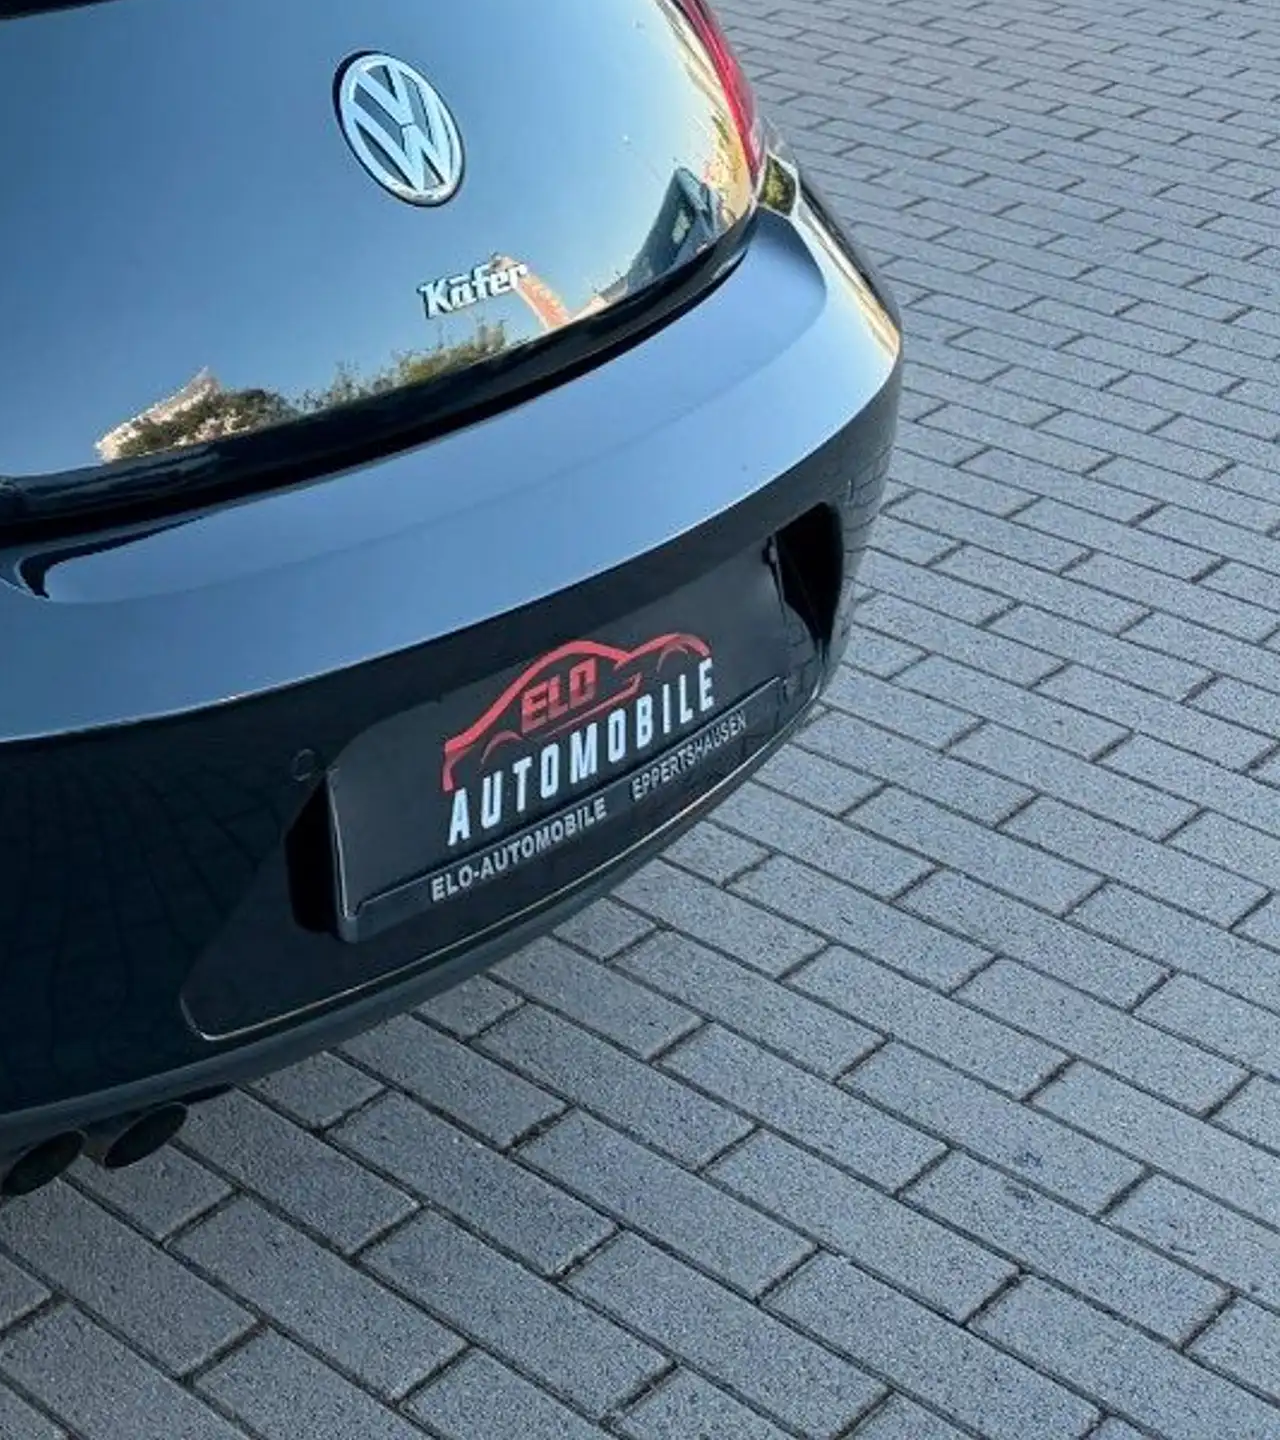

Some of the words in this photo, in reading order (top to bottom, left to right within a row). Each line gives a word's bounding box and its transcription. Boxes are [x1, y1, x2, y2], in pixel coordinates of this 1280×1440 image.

[337, 53, 463, 206] VW
[419, 261, 528, 318] Käfer
[447, 657, 715, 847] AUTOMOBILE
[521, 657, 597, 733] ELO
[430, 796, 608, 903] ELO-AUTOMOBILE
[631, 710, 747, 802] EPPERTSHAUSEN
